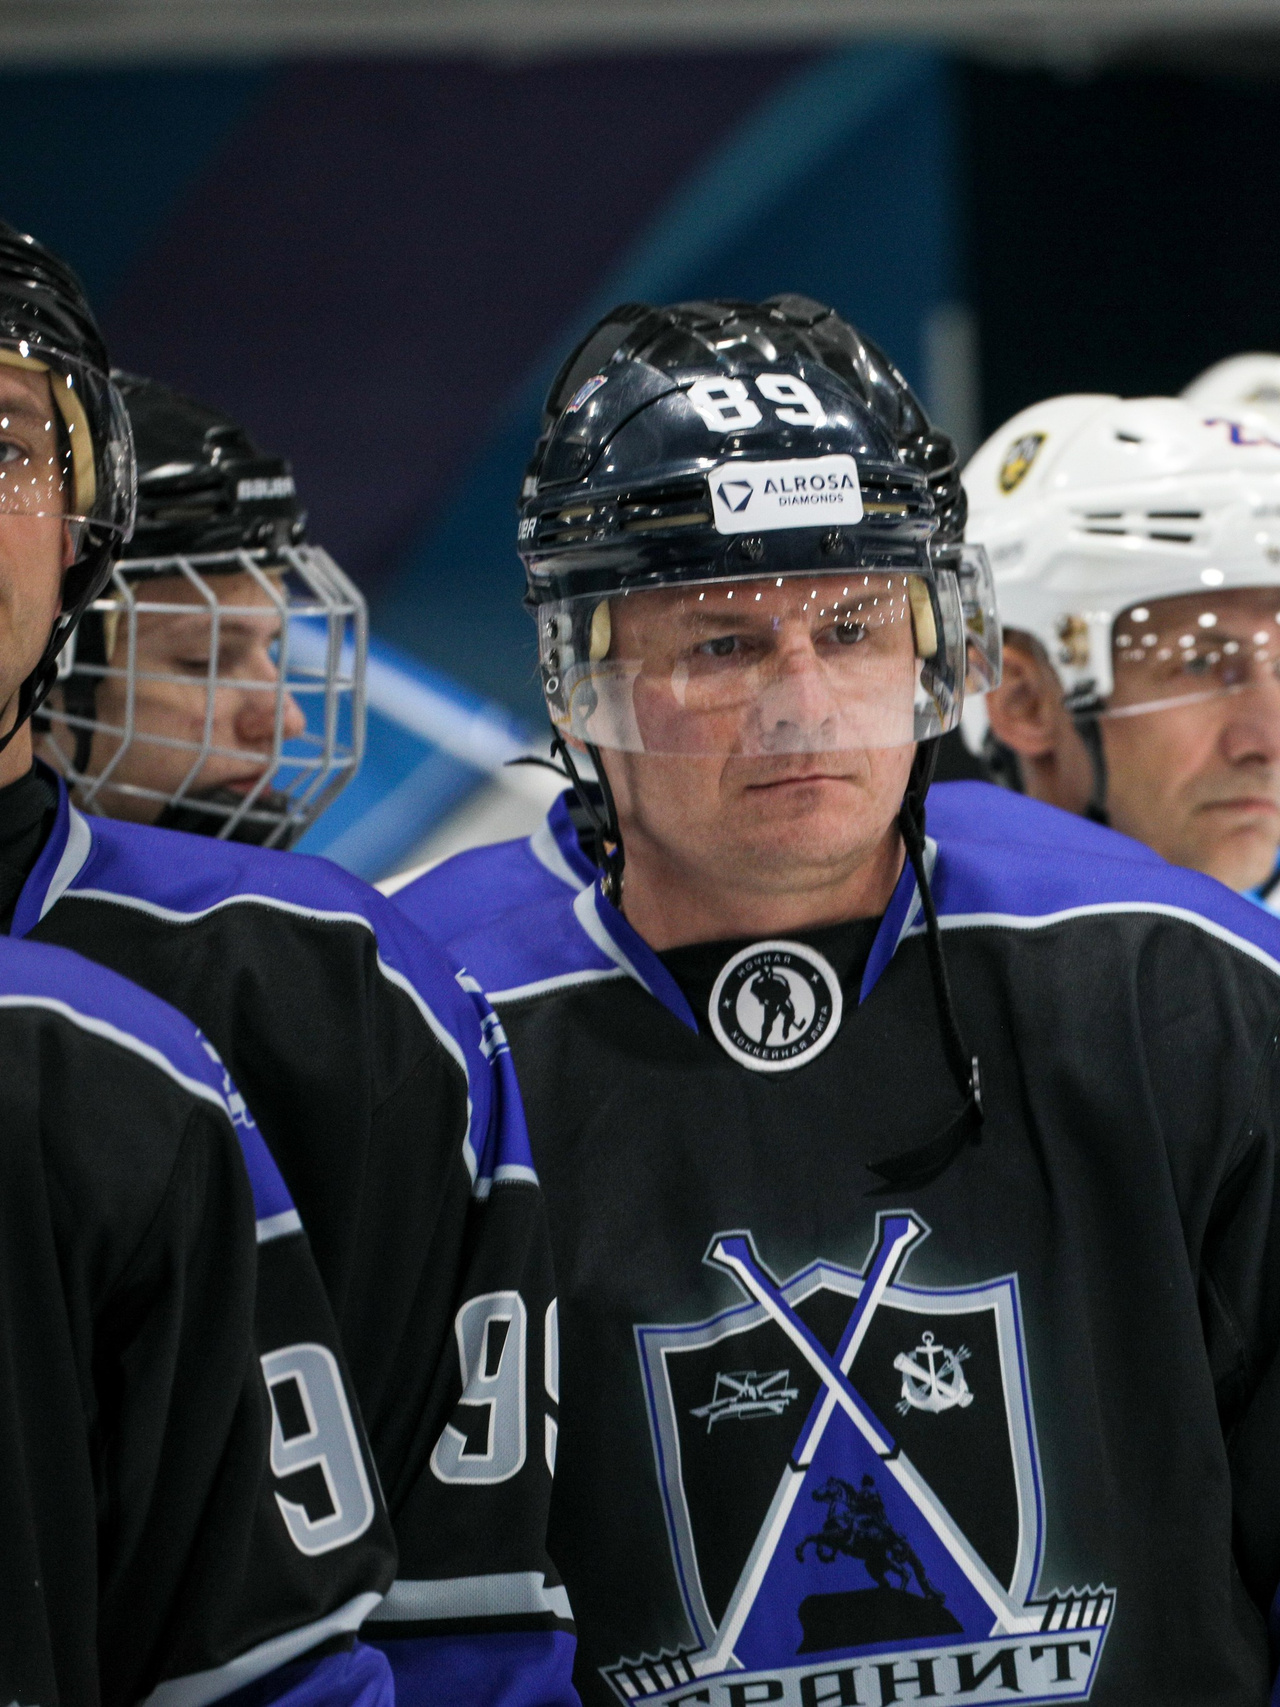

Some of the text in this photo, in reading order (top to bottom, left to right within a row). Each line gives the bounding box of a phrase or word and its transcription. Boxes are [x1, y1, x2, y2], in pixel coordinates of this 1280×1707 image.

[686, 373, 827, 433] 89
[763, 473, 855, 494] ALROSA
[778, 493, 844, 507] DIAMONDS
[737, 954, 791, 978] НОЧНАЯ
[730, 1005, 828, 1059] ХОККЕЙНАЯ ЛИГА
[430, 1290, 560, 1486] 9
[259, 1342, 376, 1557] 9
[667, 1638, 1093, 1707] РАНИТ
